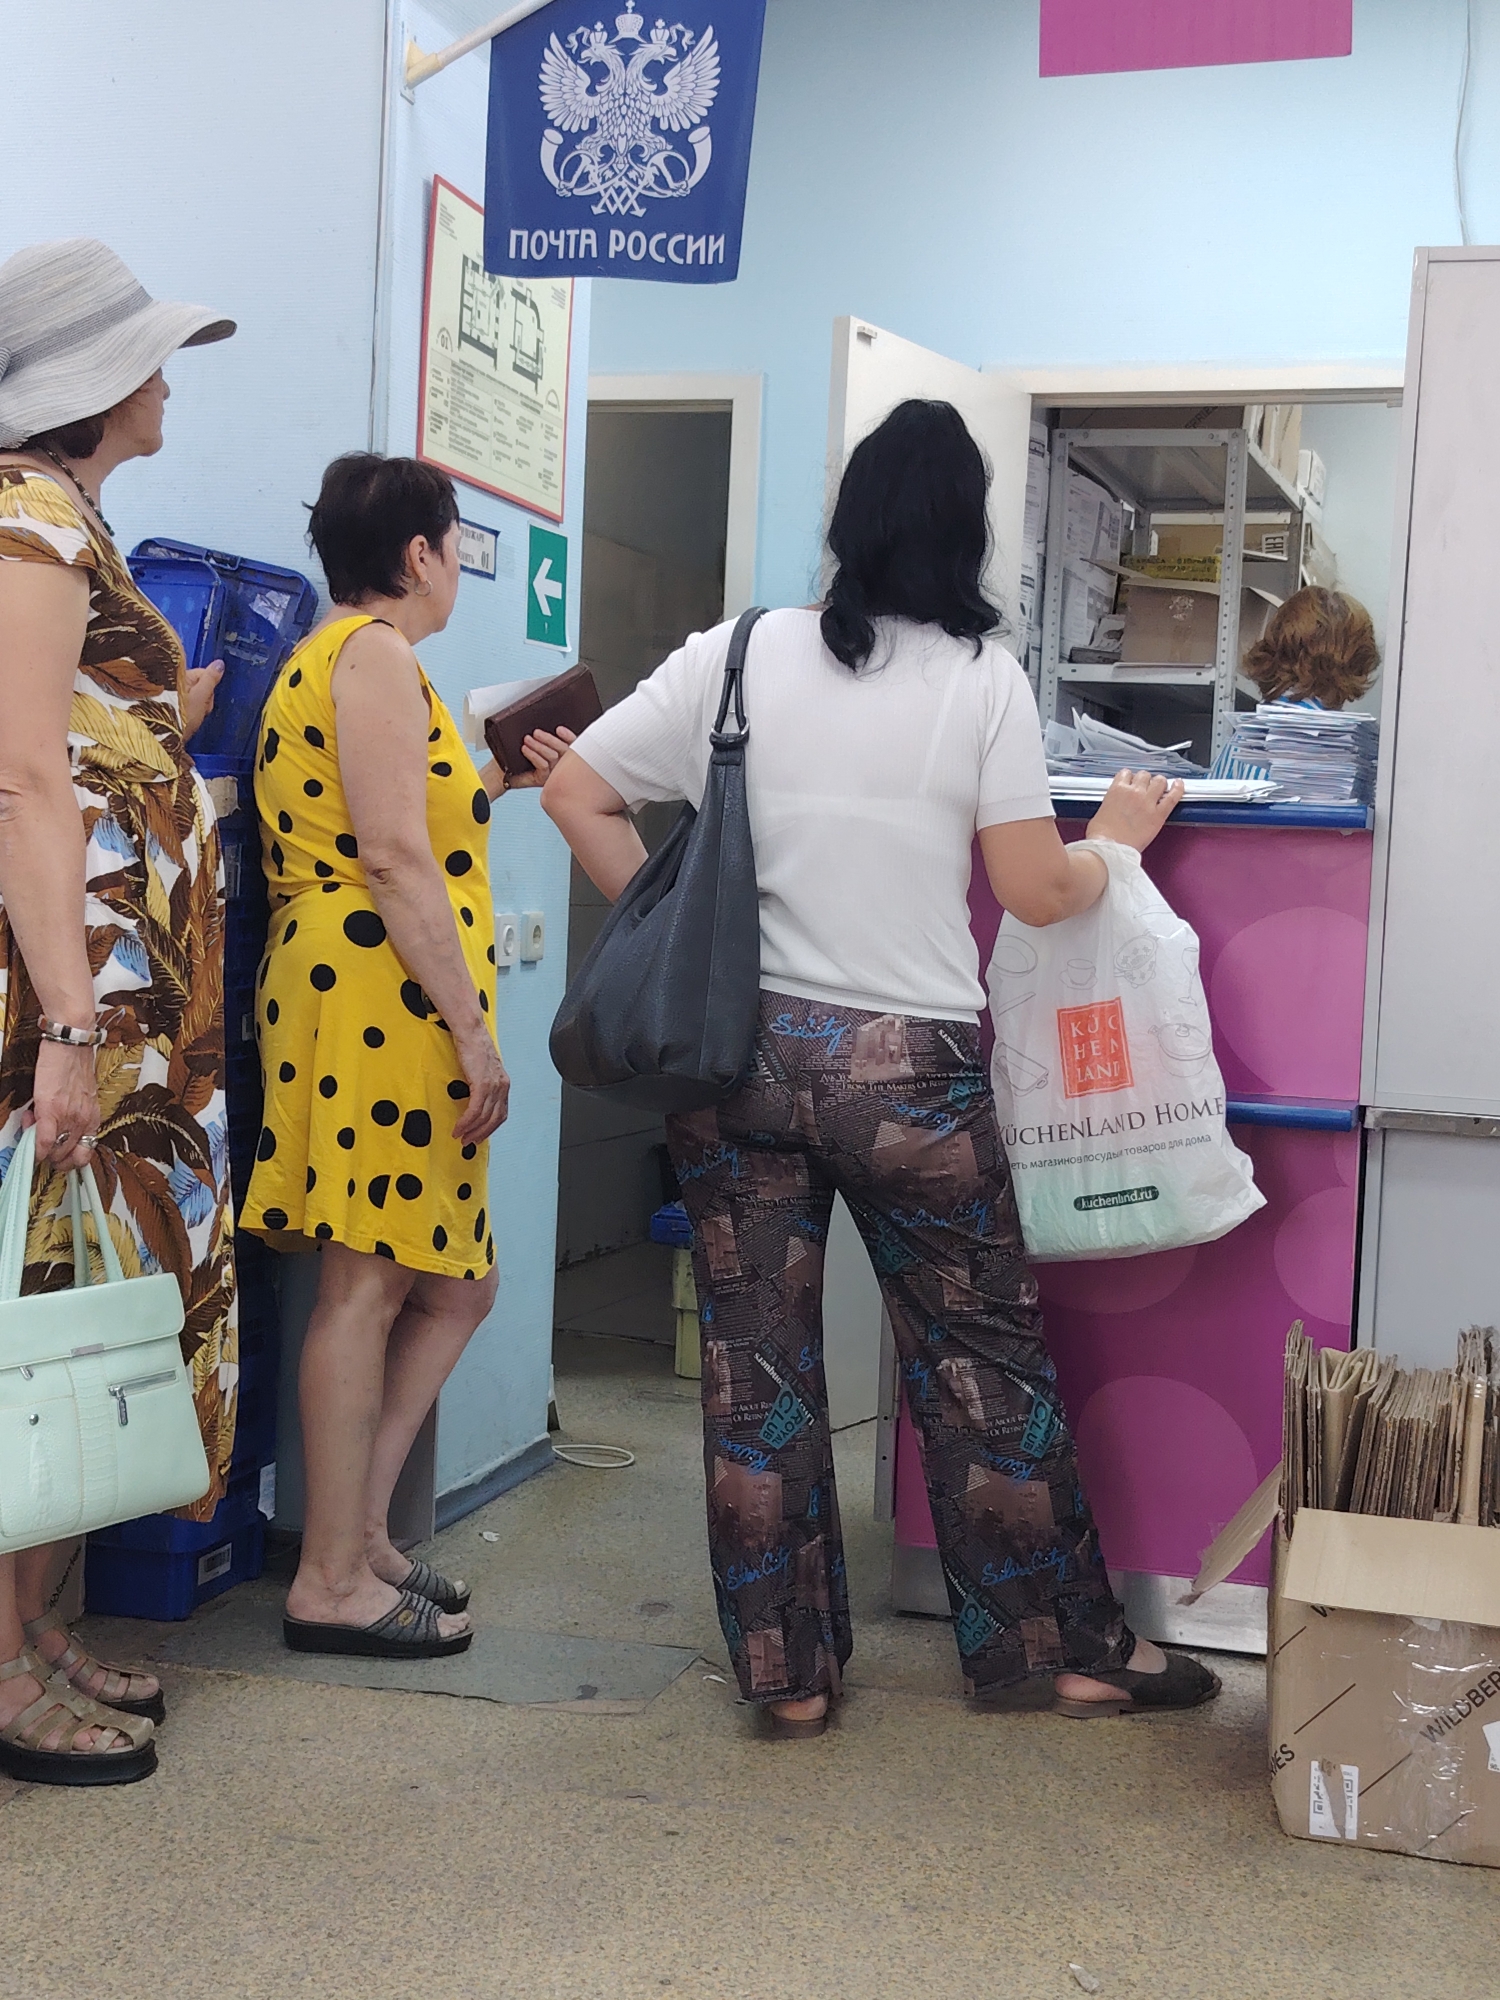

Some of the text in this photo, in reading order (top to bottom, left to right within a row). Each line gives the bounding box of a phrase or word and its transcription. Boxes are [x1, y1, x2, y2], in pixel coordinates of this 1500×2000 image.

[508, 229, 725, 265] ПОЧТА РОССИИ
[481, 551, 490, 569] 01
[1030, 1155, 1082, 1168] магазинов
[1124, 1142, 1166, 1155] товаров
[1185, 1134, 1212, 1147] дома
[762, 1390, 794, 1441] CLUB
[771, 1407, 804, 1445] ROYAL
[1023, 1401, 1048, 1451] CLUB
